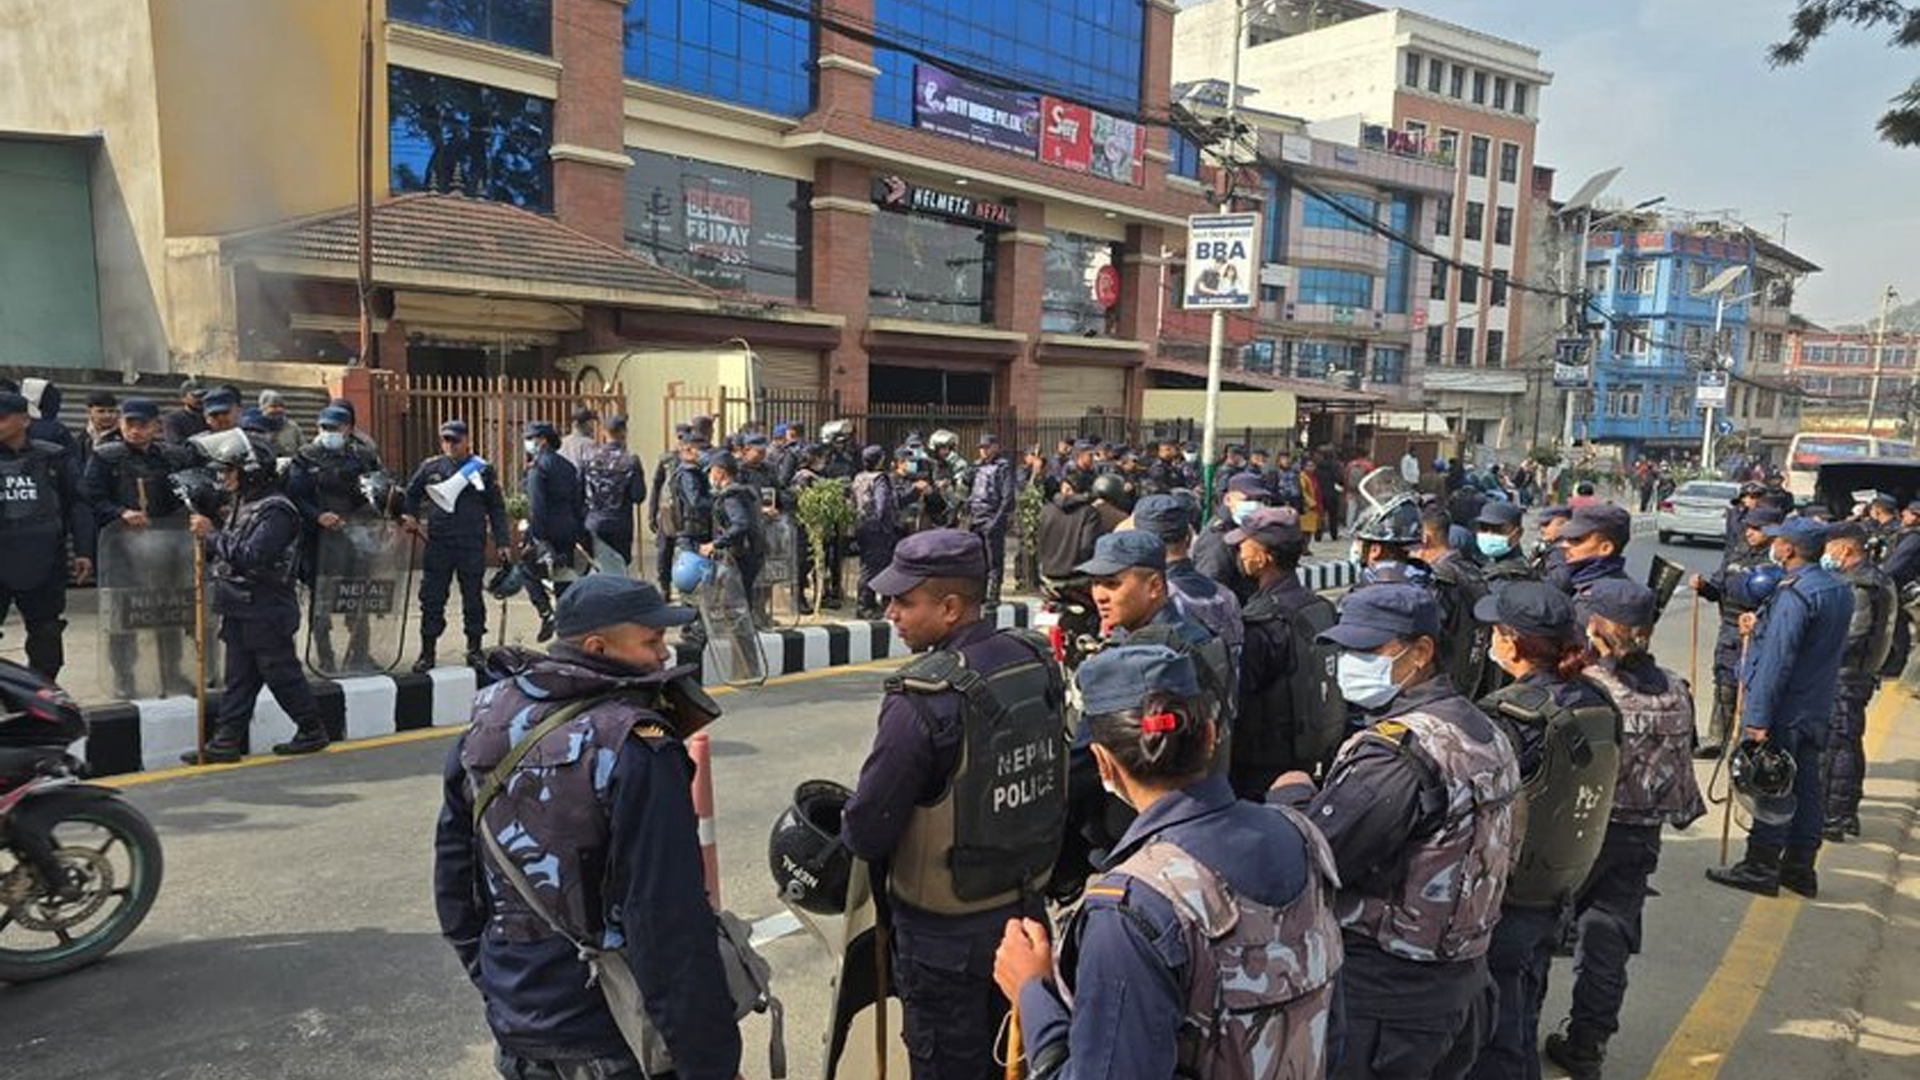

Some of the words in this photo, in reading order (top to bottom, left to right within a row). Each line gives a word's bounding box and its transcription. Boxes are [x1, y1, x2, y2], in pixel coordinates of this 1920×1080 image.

[914, 187, 970, 214] HELMETS
[975, 201, 1010, 223] NEPAL
[686, 219, 750, 247] FRIDAY
[1196, 241, 1246, 260] BBA
[997, 736, 1056, 777] NEPAL
[993, 767, 1054, 813] POLICE
[782, 854, 819, 888] NEPAL
